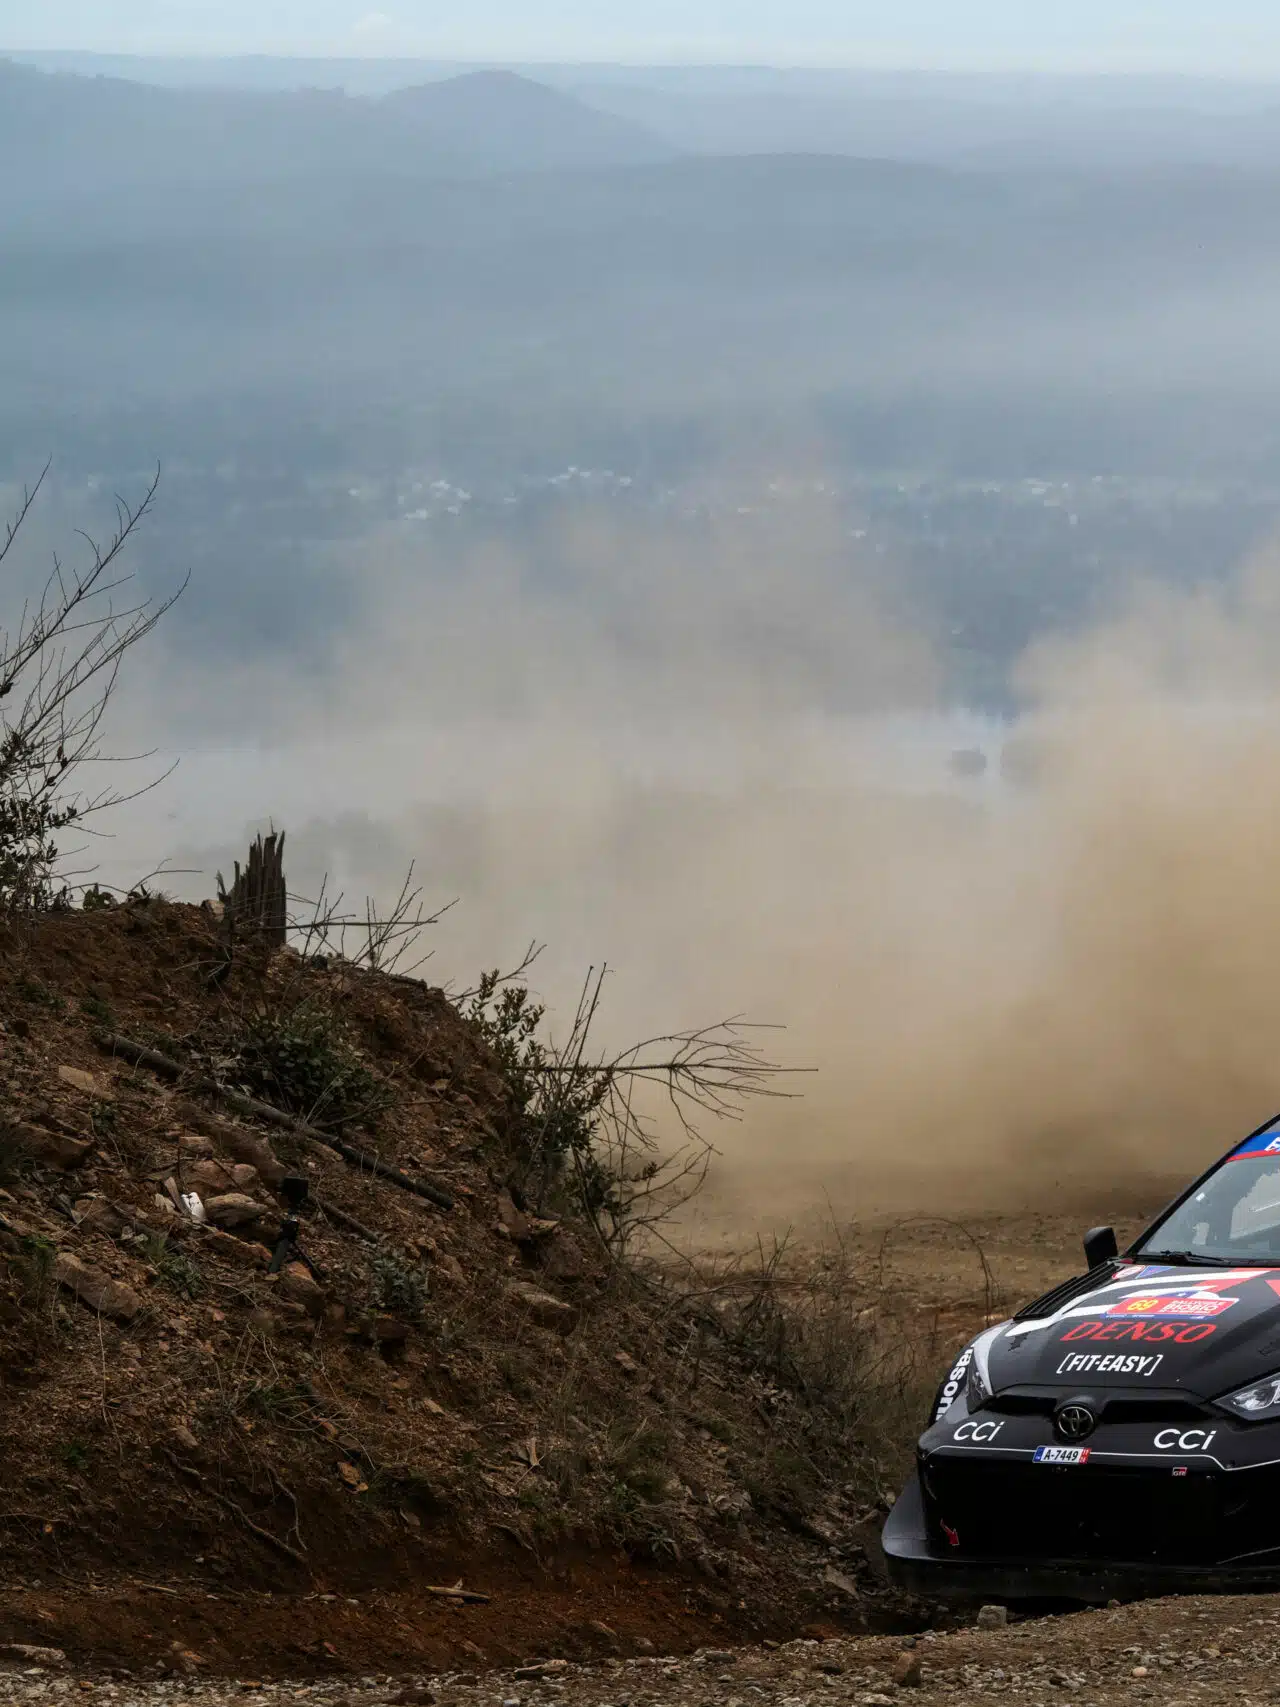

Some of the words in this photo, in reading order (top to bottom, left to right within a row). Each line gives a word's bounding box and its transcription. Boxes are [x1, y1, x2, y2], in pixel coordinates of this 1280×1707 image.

[1127, 1299, 1159, 1311] 69
[1060, 1321, 1217, 1343] DENSO
[1043, 1449, 1079, 1461] A-7449
